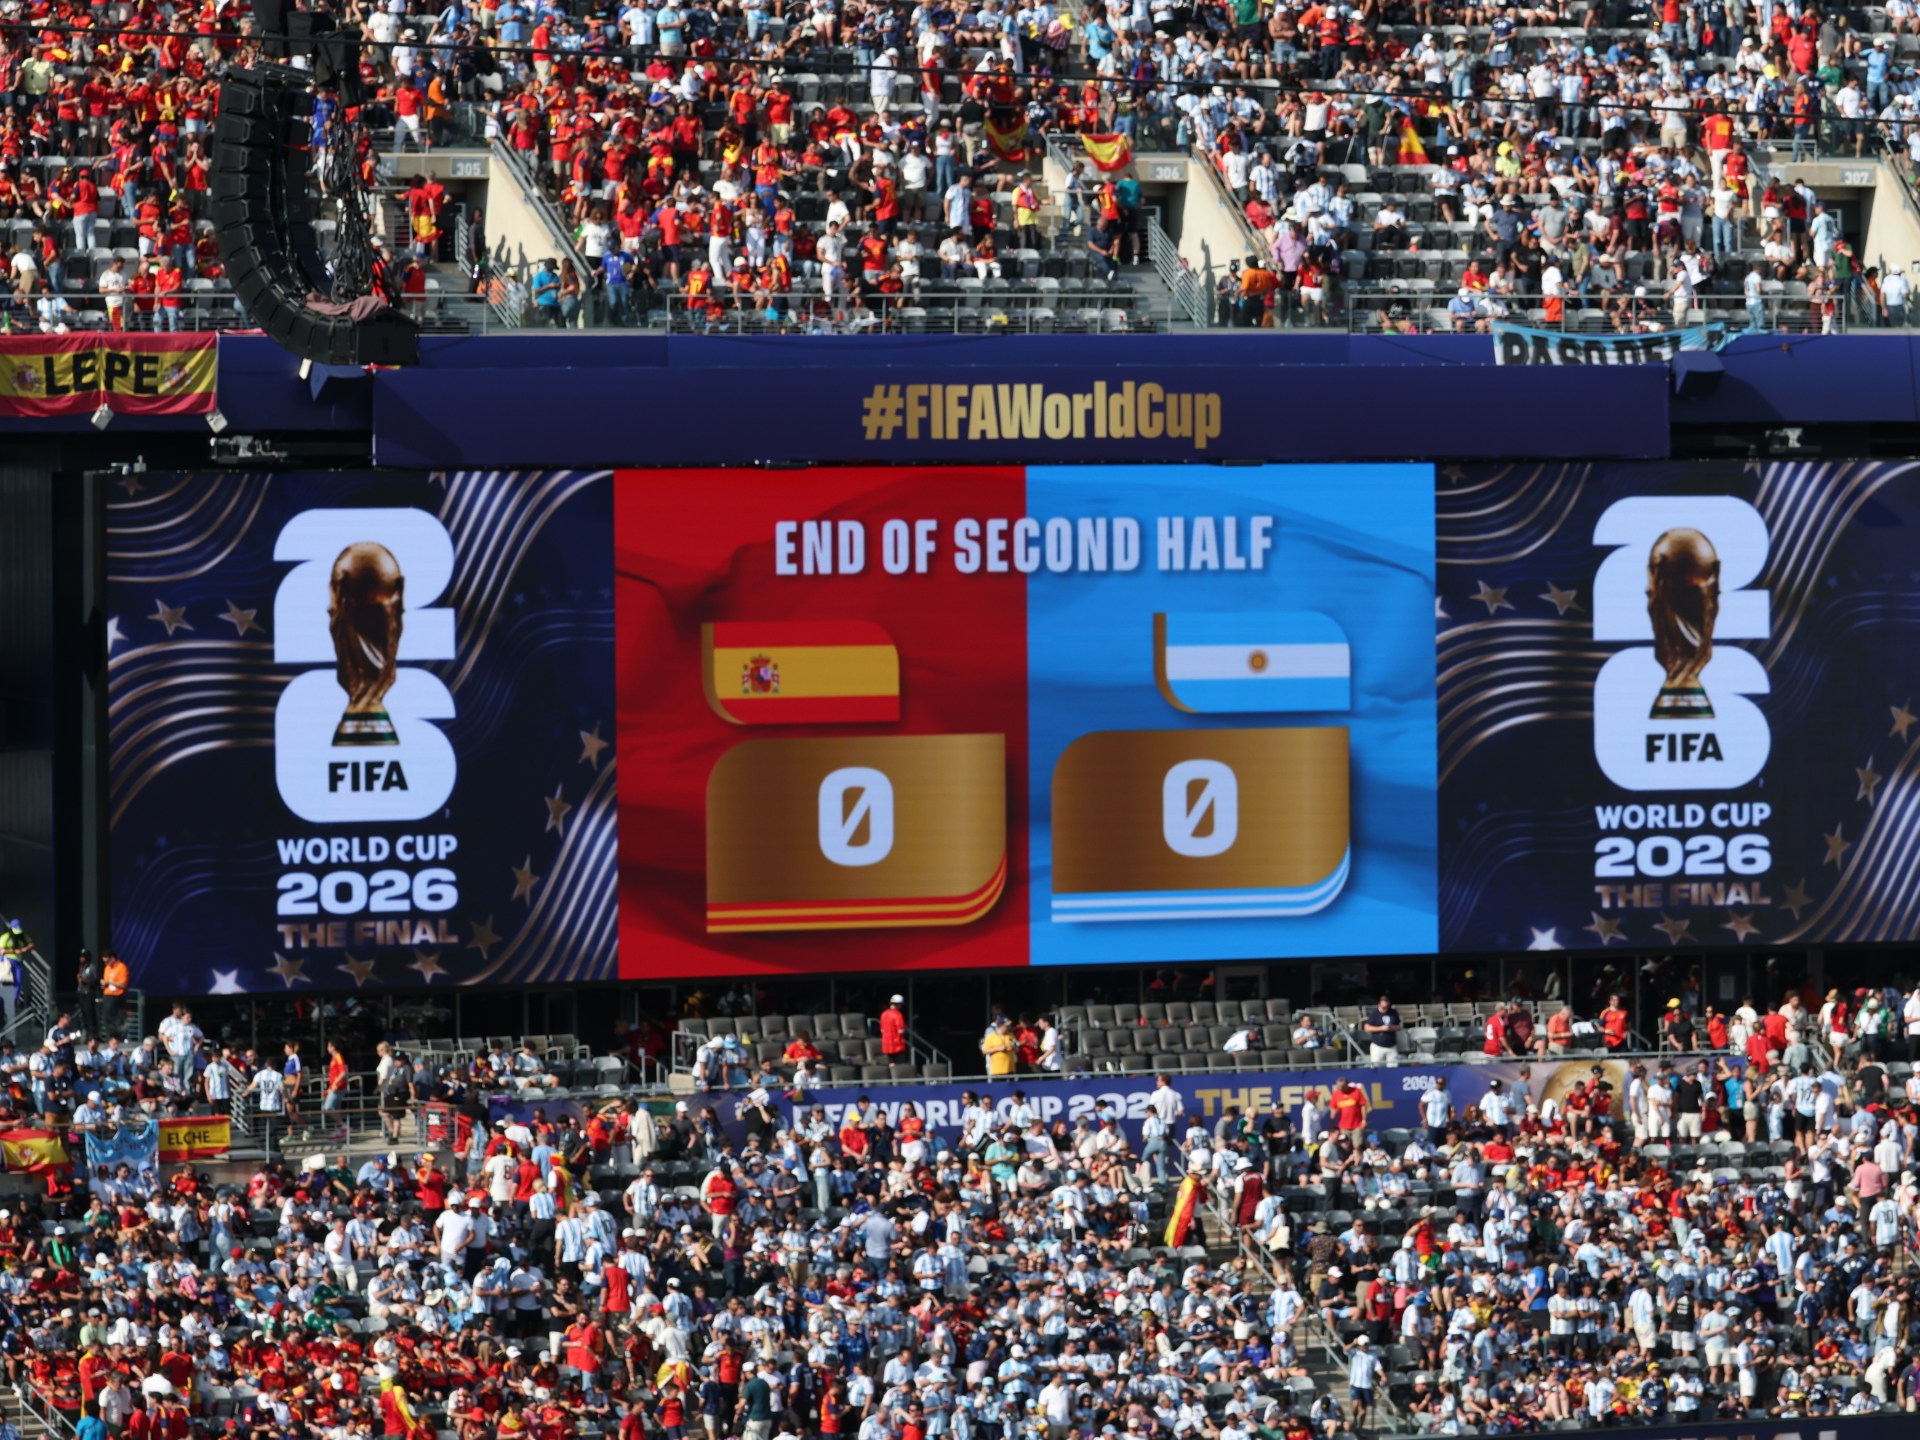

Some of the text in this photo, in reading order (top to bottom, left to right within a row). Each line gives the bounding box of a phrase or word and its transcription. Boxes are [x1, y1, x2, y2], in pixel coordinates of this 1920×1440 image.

[456, 162, 481, 176] 305
[1156, 166, 1180, 179] 306
[1844, 172, 1870, 184] 307
[43, 351, 160, 396] LEPE
[862, 380, 1223, 449] #FIFAWorldCup
[775, 515, 1275, 577] END OF SECOND HALF
[1646, 733, 1723, 762] FIFA
[328, 760, 408, 793] FIFA
[817, 766, 895, 867] 0
[1162, 758, 1239, 857] 0
[1594, 802, 1771, 831] WORLD CUP
[276, 834, 458, 865] WORLD CUP
[1594, 833, 1772, 878] 2026
[276, 867, 459, 916] 2026
[1594, 881, 1772, 909] THE FINAL
[276, 918, 459, 949] THE FINAL
[1068, 1091, 1152, 1122] 202
[1195, 1087, 1273, 1117] THE
[167, 1130, 212, 1145] ELCHE
